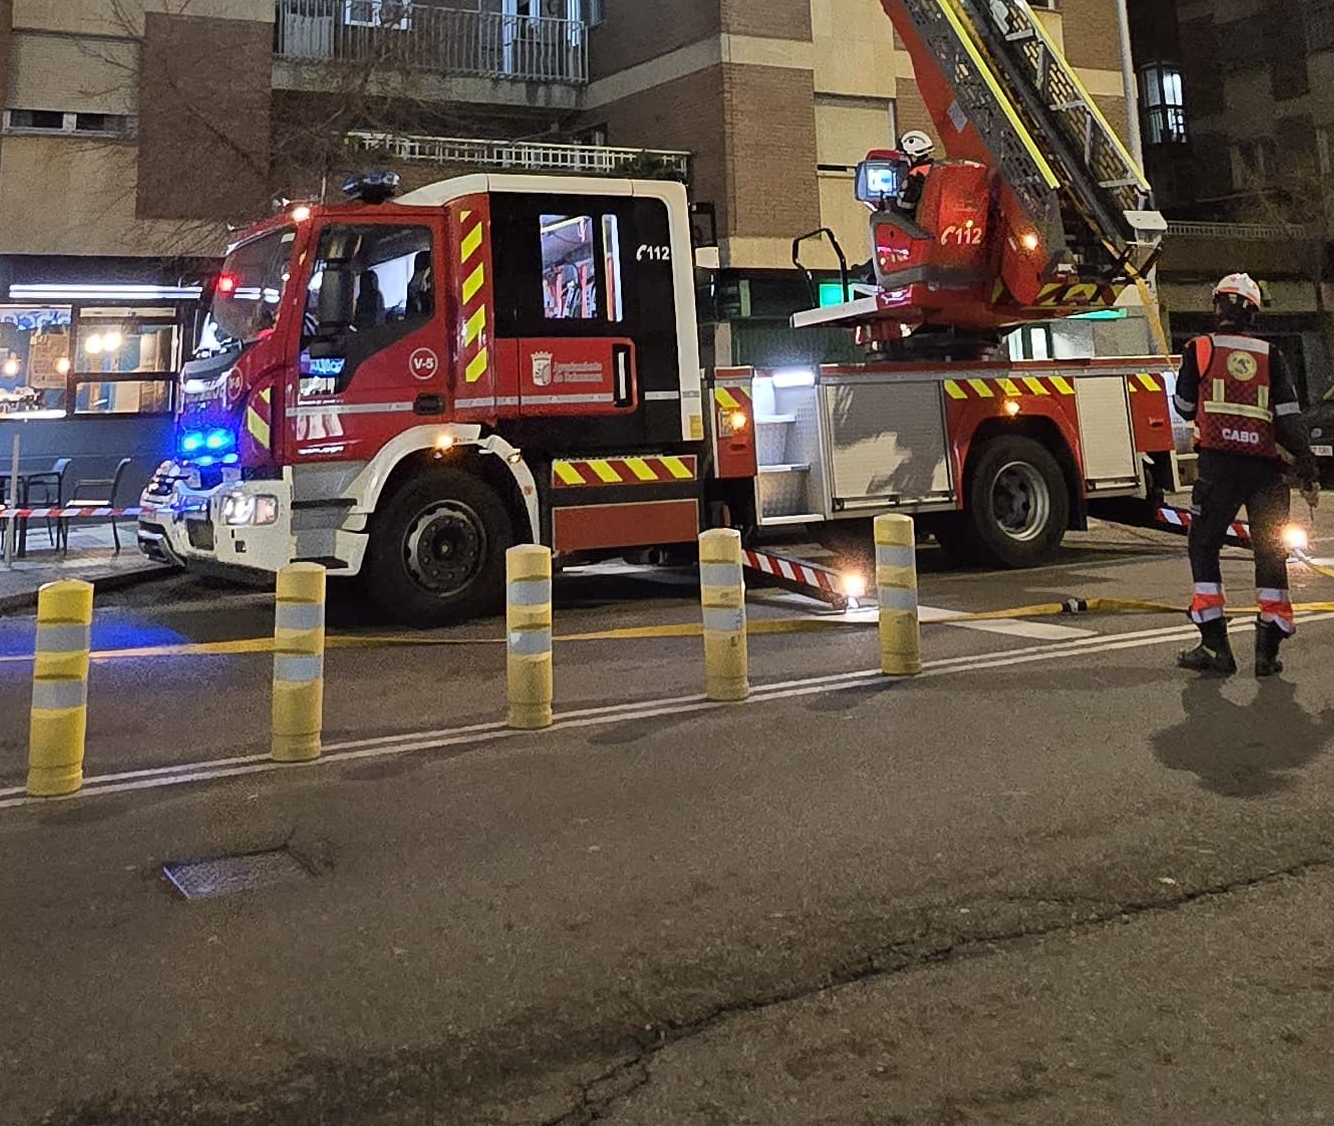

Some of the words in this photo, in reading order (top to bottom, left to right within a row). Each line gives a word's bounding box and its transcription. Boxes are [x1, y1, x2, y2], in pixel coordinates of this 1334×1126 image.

[954, 227, 982, 245] 112
[646, 245, 670, 261] 112
[413, 357, 434, 370] V-5
[1221, 428, 1260, 444] CABO
